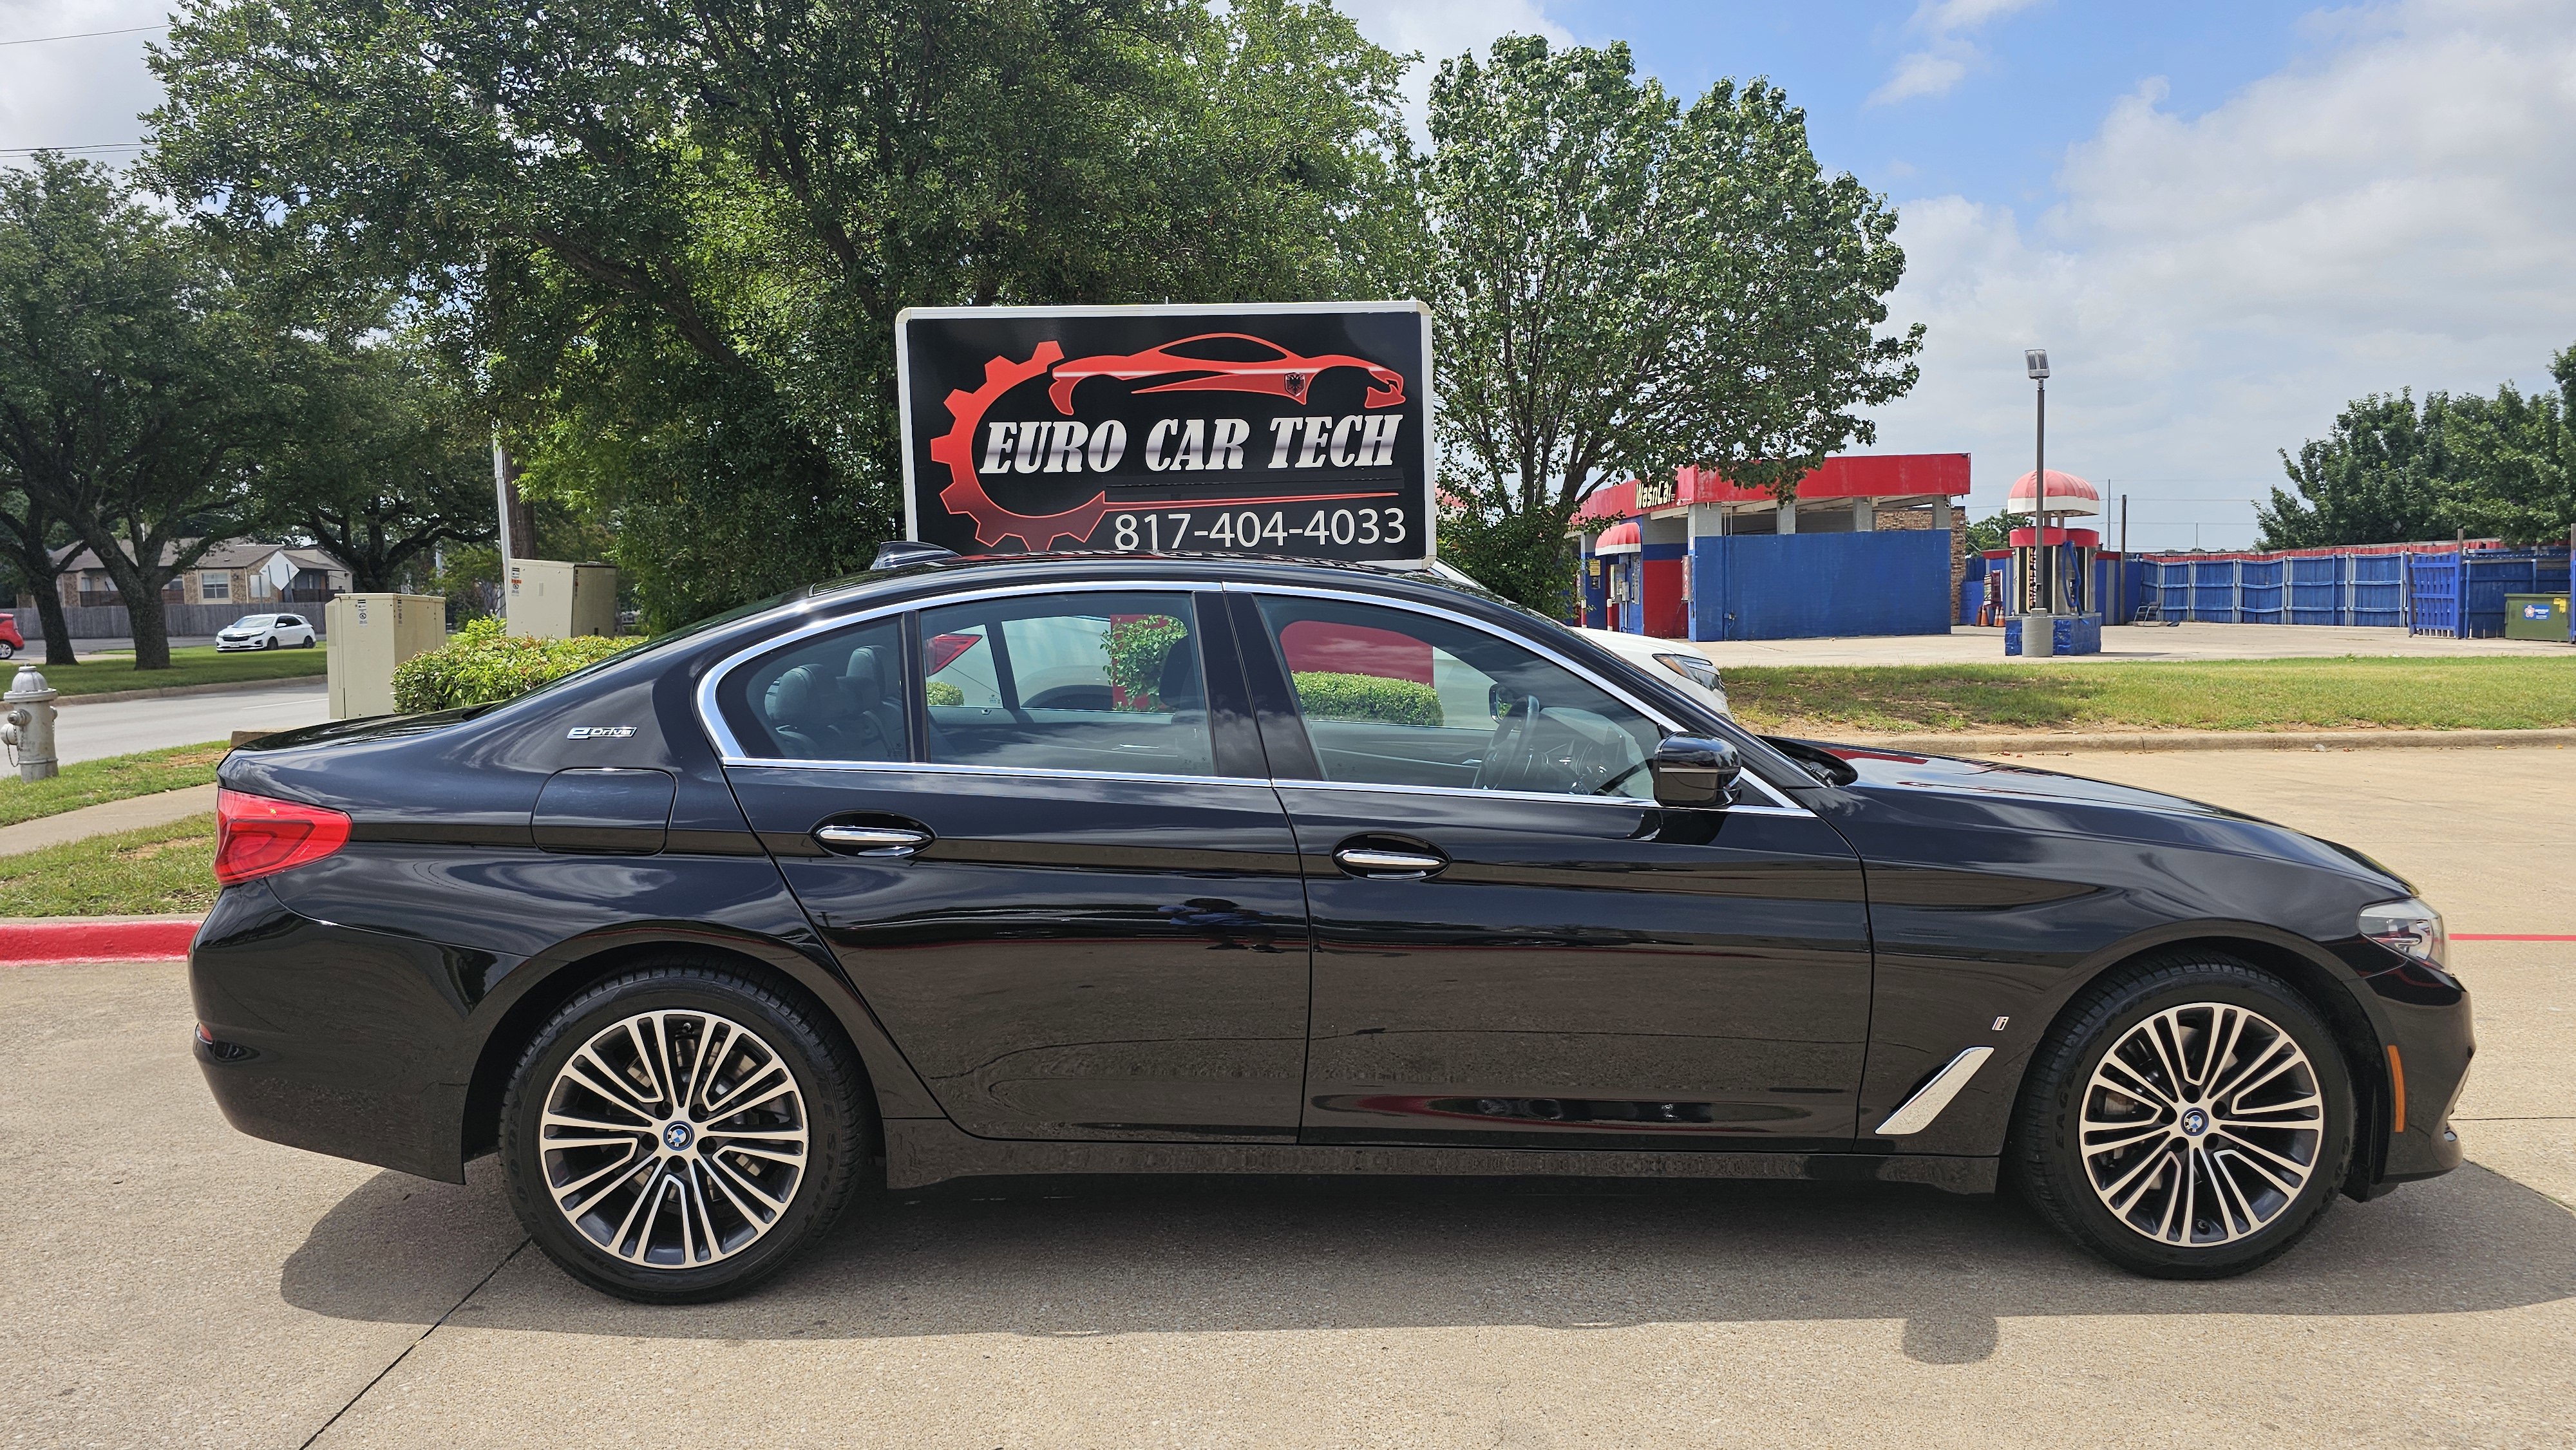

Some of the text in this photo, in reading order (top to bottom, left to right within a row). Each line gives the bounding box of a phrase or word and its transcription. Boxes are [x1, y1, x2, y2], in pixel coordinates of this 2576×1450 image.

[979, 414, 1403, 474] EURO CAR TECH
[1115, 508, 1406, 551] 817-404-4033
